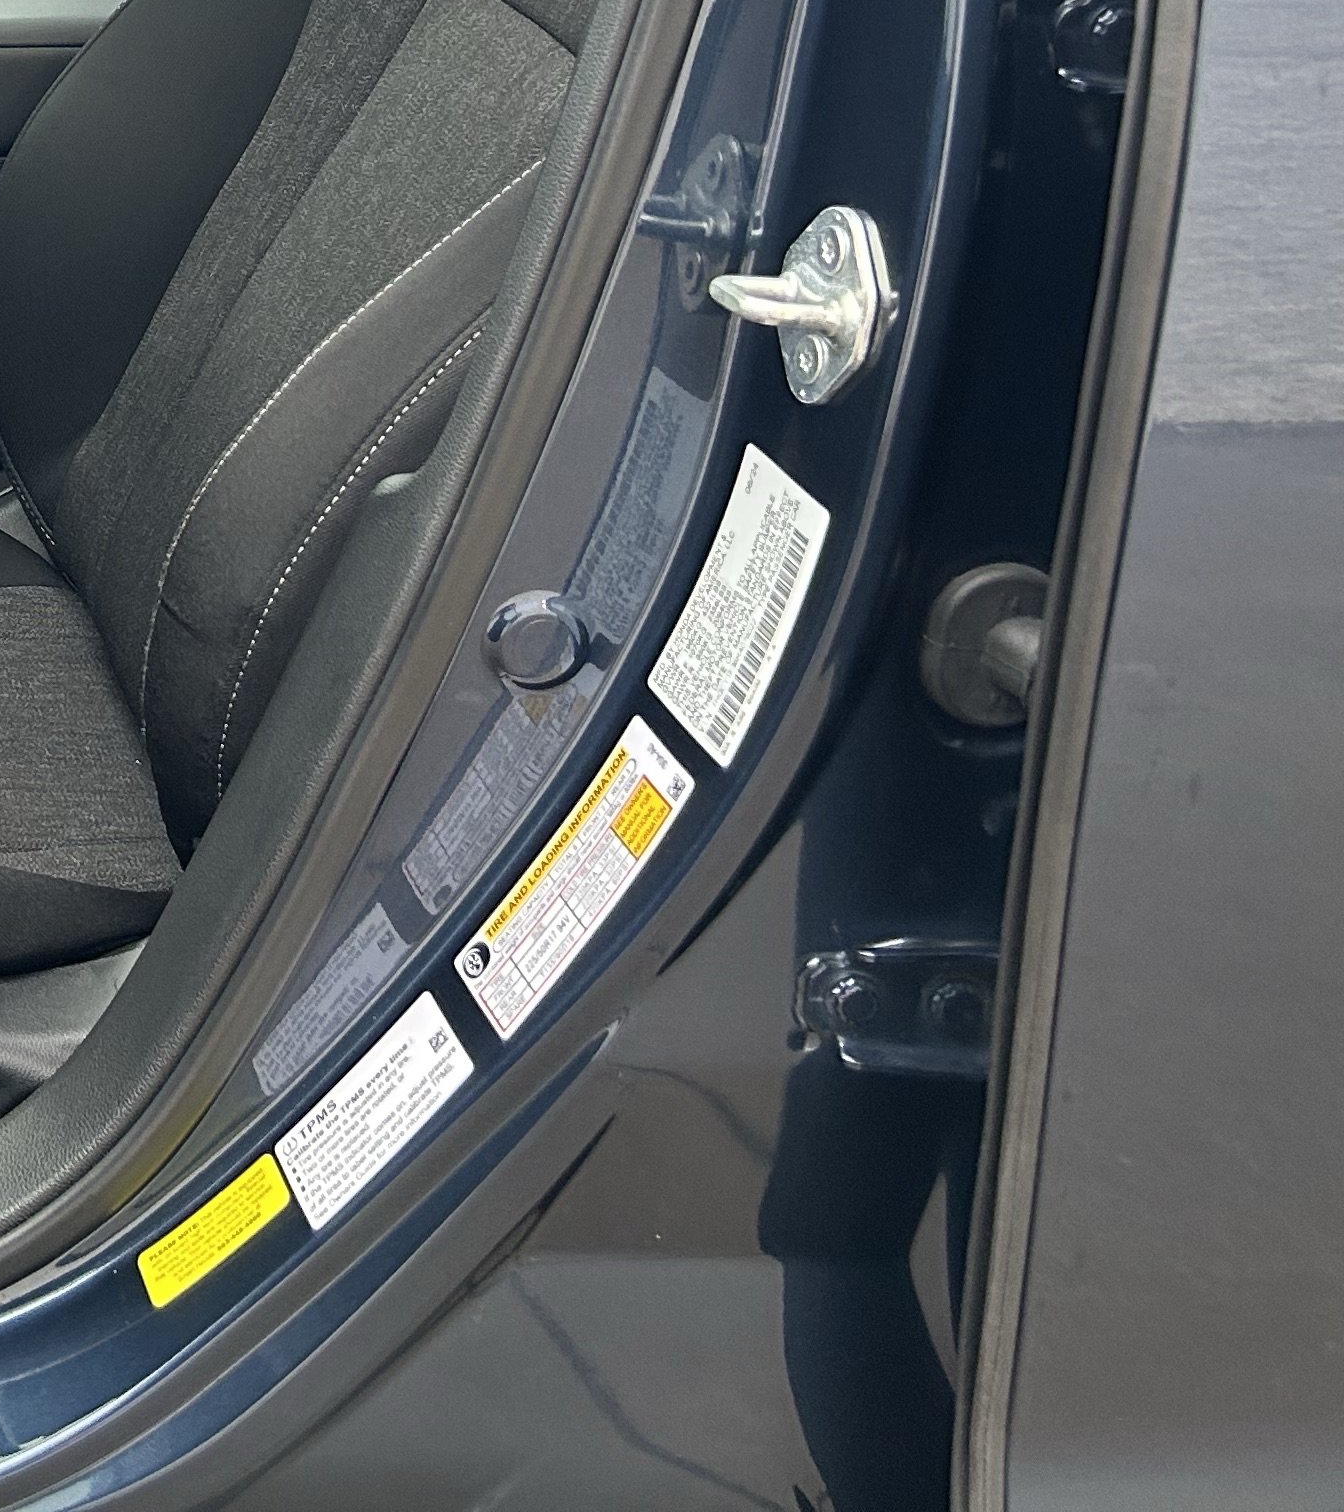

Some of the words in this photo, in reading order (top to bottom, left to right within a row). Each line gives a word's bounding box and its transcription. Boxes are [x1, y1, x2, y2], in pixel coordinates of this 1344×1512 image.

[484, 909, 508, 940] TIRE
[506, 883, 528, 913] AND
[527, 830, 570, 886] LOADING
[567, 747, 629, 834] INFORMATION
[285, 1127, 324, 1167] Calibrate
[324, 1112, 339, 1129] the
[339, 1085, 365, 1114] TPMS
[298, 1097, 337, 1141] TPMS
